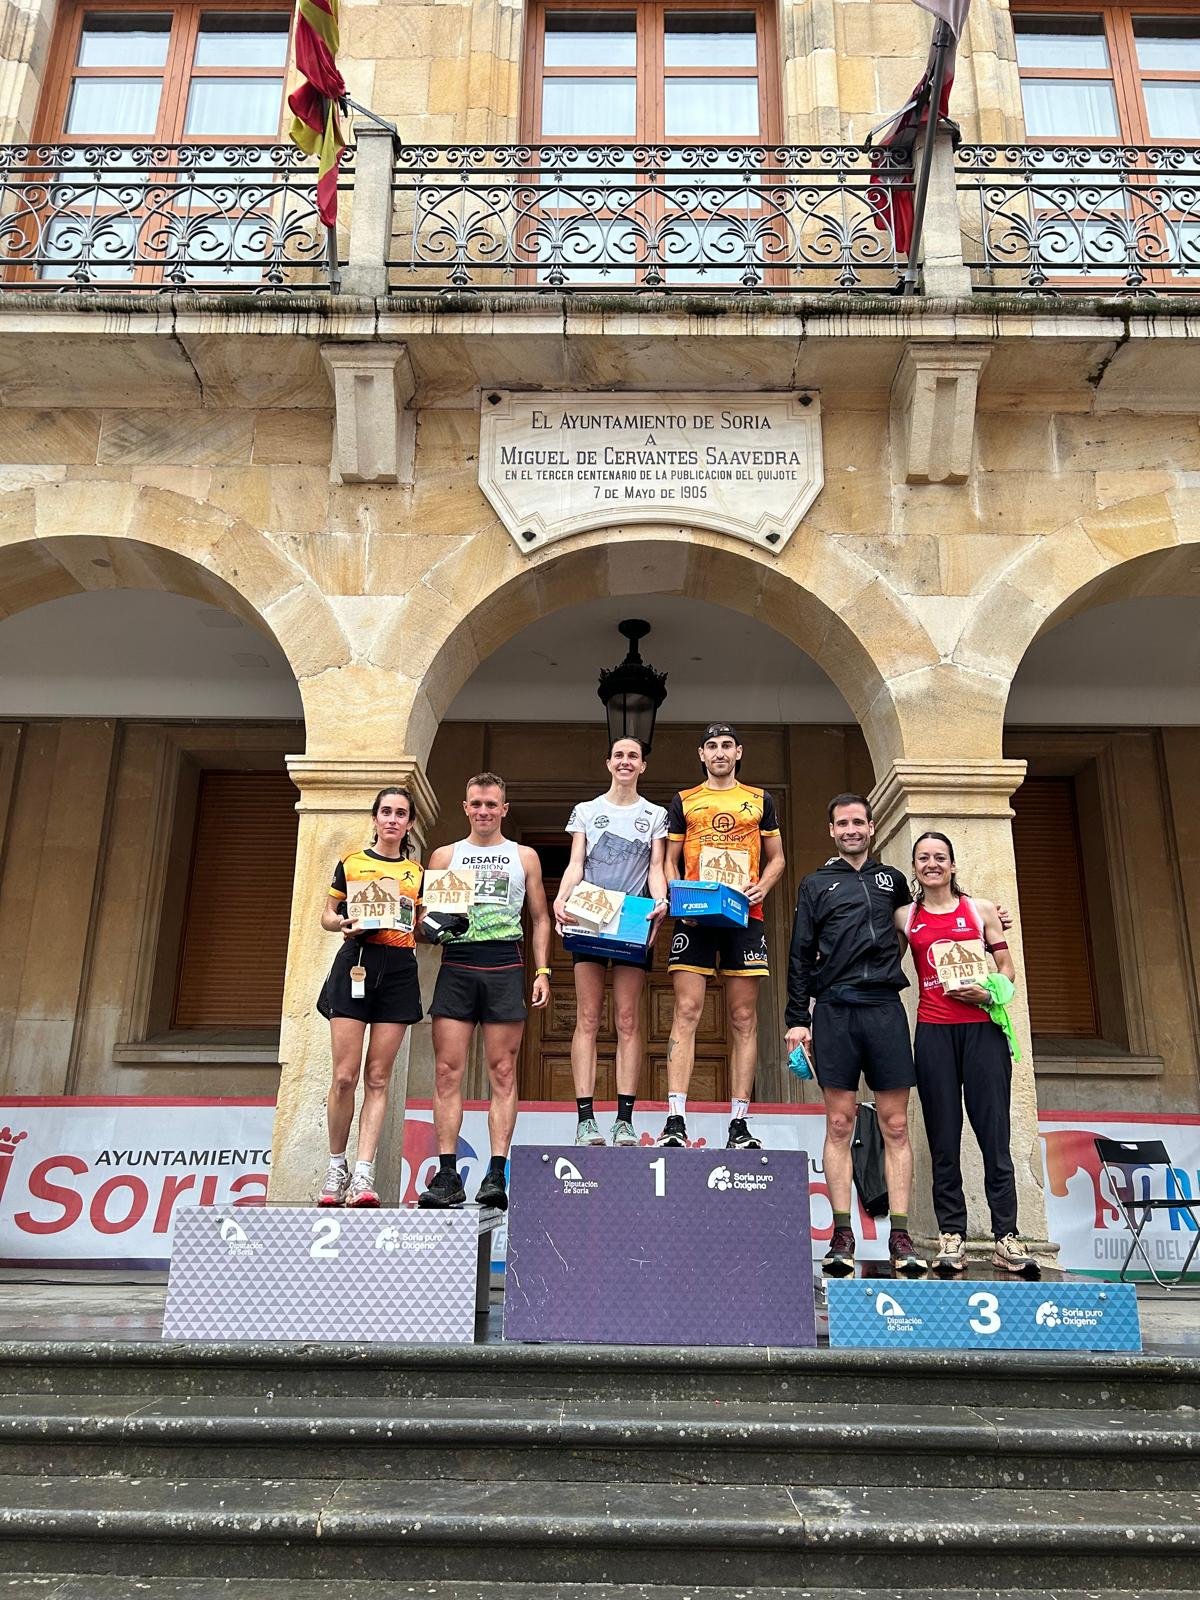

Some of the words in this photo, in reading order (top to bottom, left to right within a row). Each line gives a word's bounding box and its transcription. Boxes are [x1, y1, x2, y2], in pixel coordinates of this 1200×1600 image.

[532, 410, 553, 429] EL
[560, 411, 687, 429] AYUNTAMIENTO
[693, 415, 714, 429] DE
[721, 411, 772, 429] SORIA
[645, 433, 657, 446] A
[500, 446, 569, 465] MIGUEL
[576, 450, 597, 465] DE
[604, 446, 698, 465] CERVANTES
[706, 446, 800, 465] SAAVEDRA
[505, 470, 518, 480] EN
[521, 470, 533, 480] EL
[537, 470, 574, 480] TERCER
[577, 470, 637, 480] CENTENARIO
[640, 470, 652, 480] DE
[655, 470, 667, 480] LA
[671, 470, 732, 480] PUBLICACION
[736, 470, 753, 480] DEL
[757, 470, 797, 482] QUIJOTE
[593, 485, 601, 499] 7
[604, 488, 619, 499] DE
[624, 485, 655, 499] MAYO
[661, 488, 675, 499] DE
[680, 485, 707, 499] 1905
[462, 854, 510, 865] DESAFÍO
[649, 1157, 666, 1197] 1
[733, 1172, 755, 1181] Soria
[755, 1174, 774, 1184] puro
[563, 1180, 599, 1189] Diputación
[563, 1186, 572, 1194] de
[310, 1218, 341, 1258] 2
[402, 1232, 424, 1241] Soria
[424, 1234, 443, 1244] puro
[1155, 1239, 1185, 1260] DEL
[968, 1291, 1002, 1335] 3
[1062, 1307, 1084, 1316] Soria
[1084, 1309, 1103, 1319] puro
[887, 1316, 923, 1326] Diputación
[896, 1323, 914, 1332] Soria
